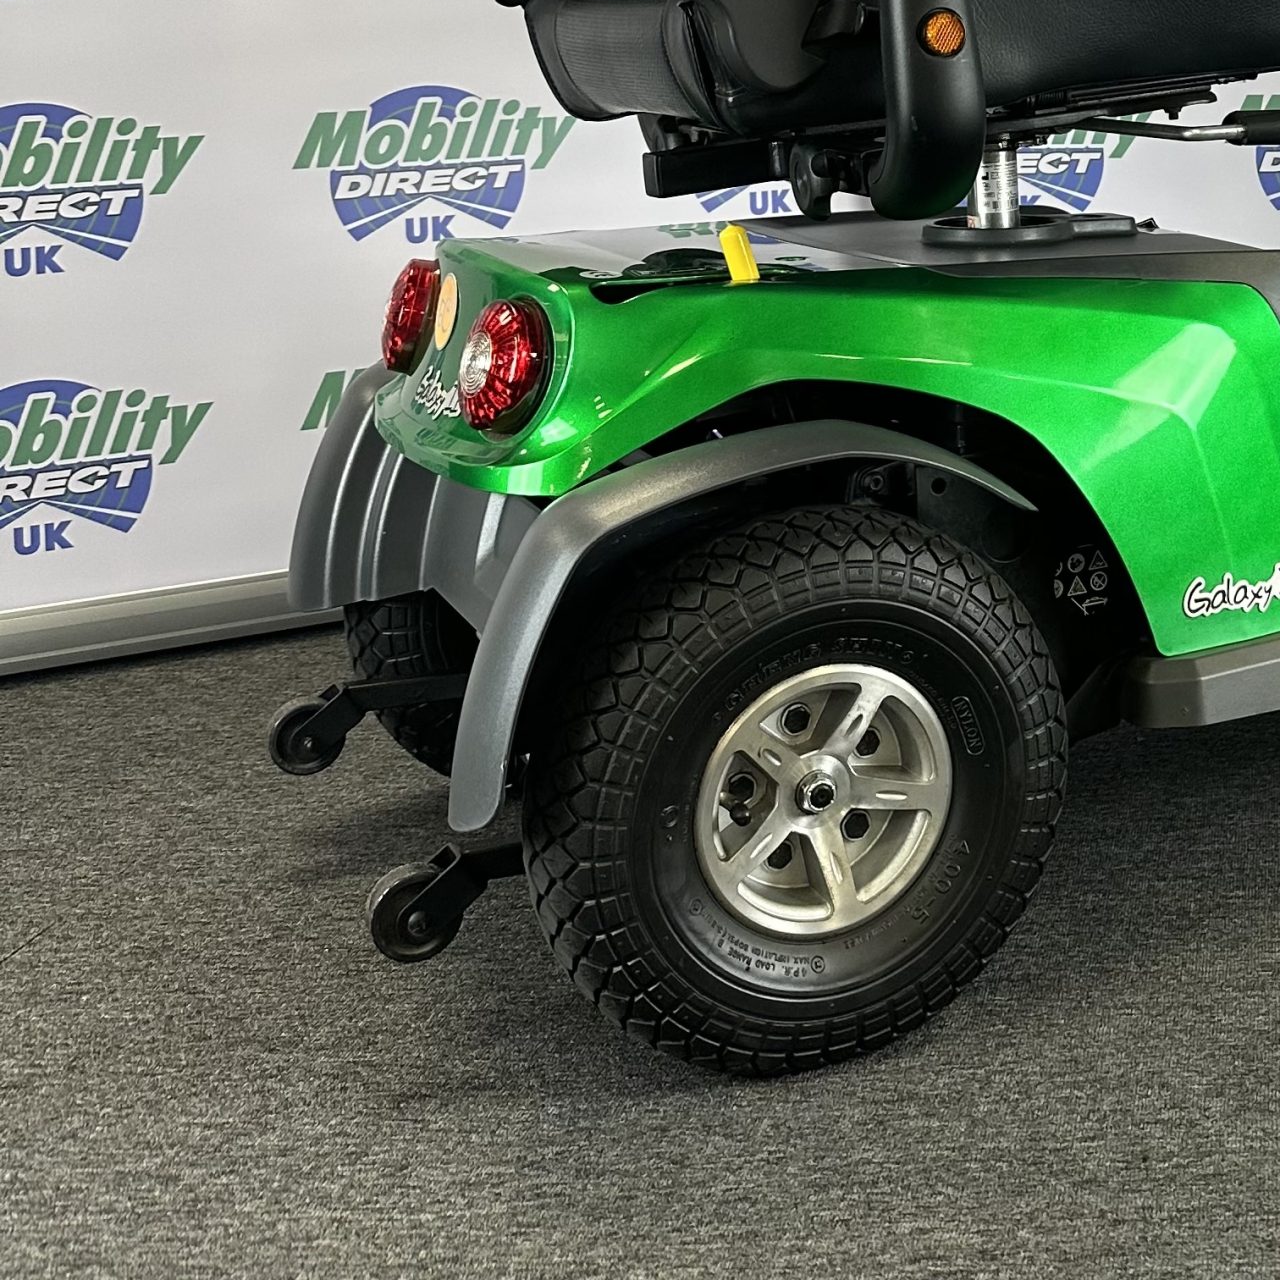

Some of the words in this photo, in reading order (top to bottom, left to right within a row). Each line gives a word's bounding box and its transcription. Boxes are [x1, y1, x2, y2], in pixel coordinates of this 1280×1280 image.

[292, 98, 578, 171] Mobility
[0, 117, 205, 195] bility
[1016, 151, 1102, 174] ECT
[334, 163, 522, 200] DIRECT
[0, 189, 140, 223] RECT
[749, 189, 792, 216] UK
[405, 214, 455, 244] UK
[4, 245, 65, 277] UK
[0, 389, 214, 466] bility
[0, 460, 149, 503] RECT
[13, 520, 74, 555] UK
[1186, 576, 1274, 615] Galaxy
[953, 698, 984, 749] NYLON
